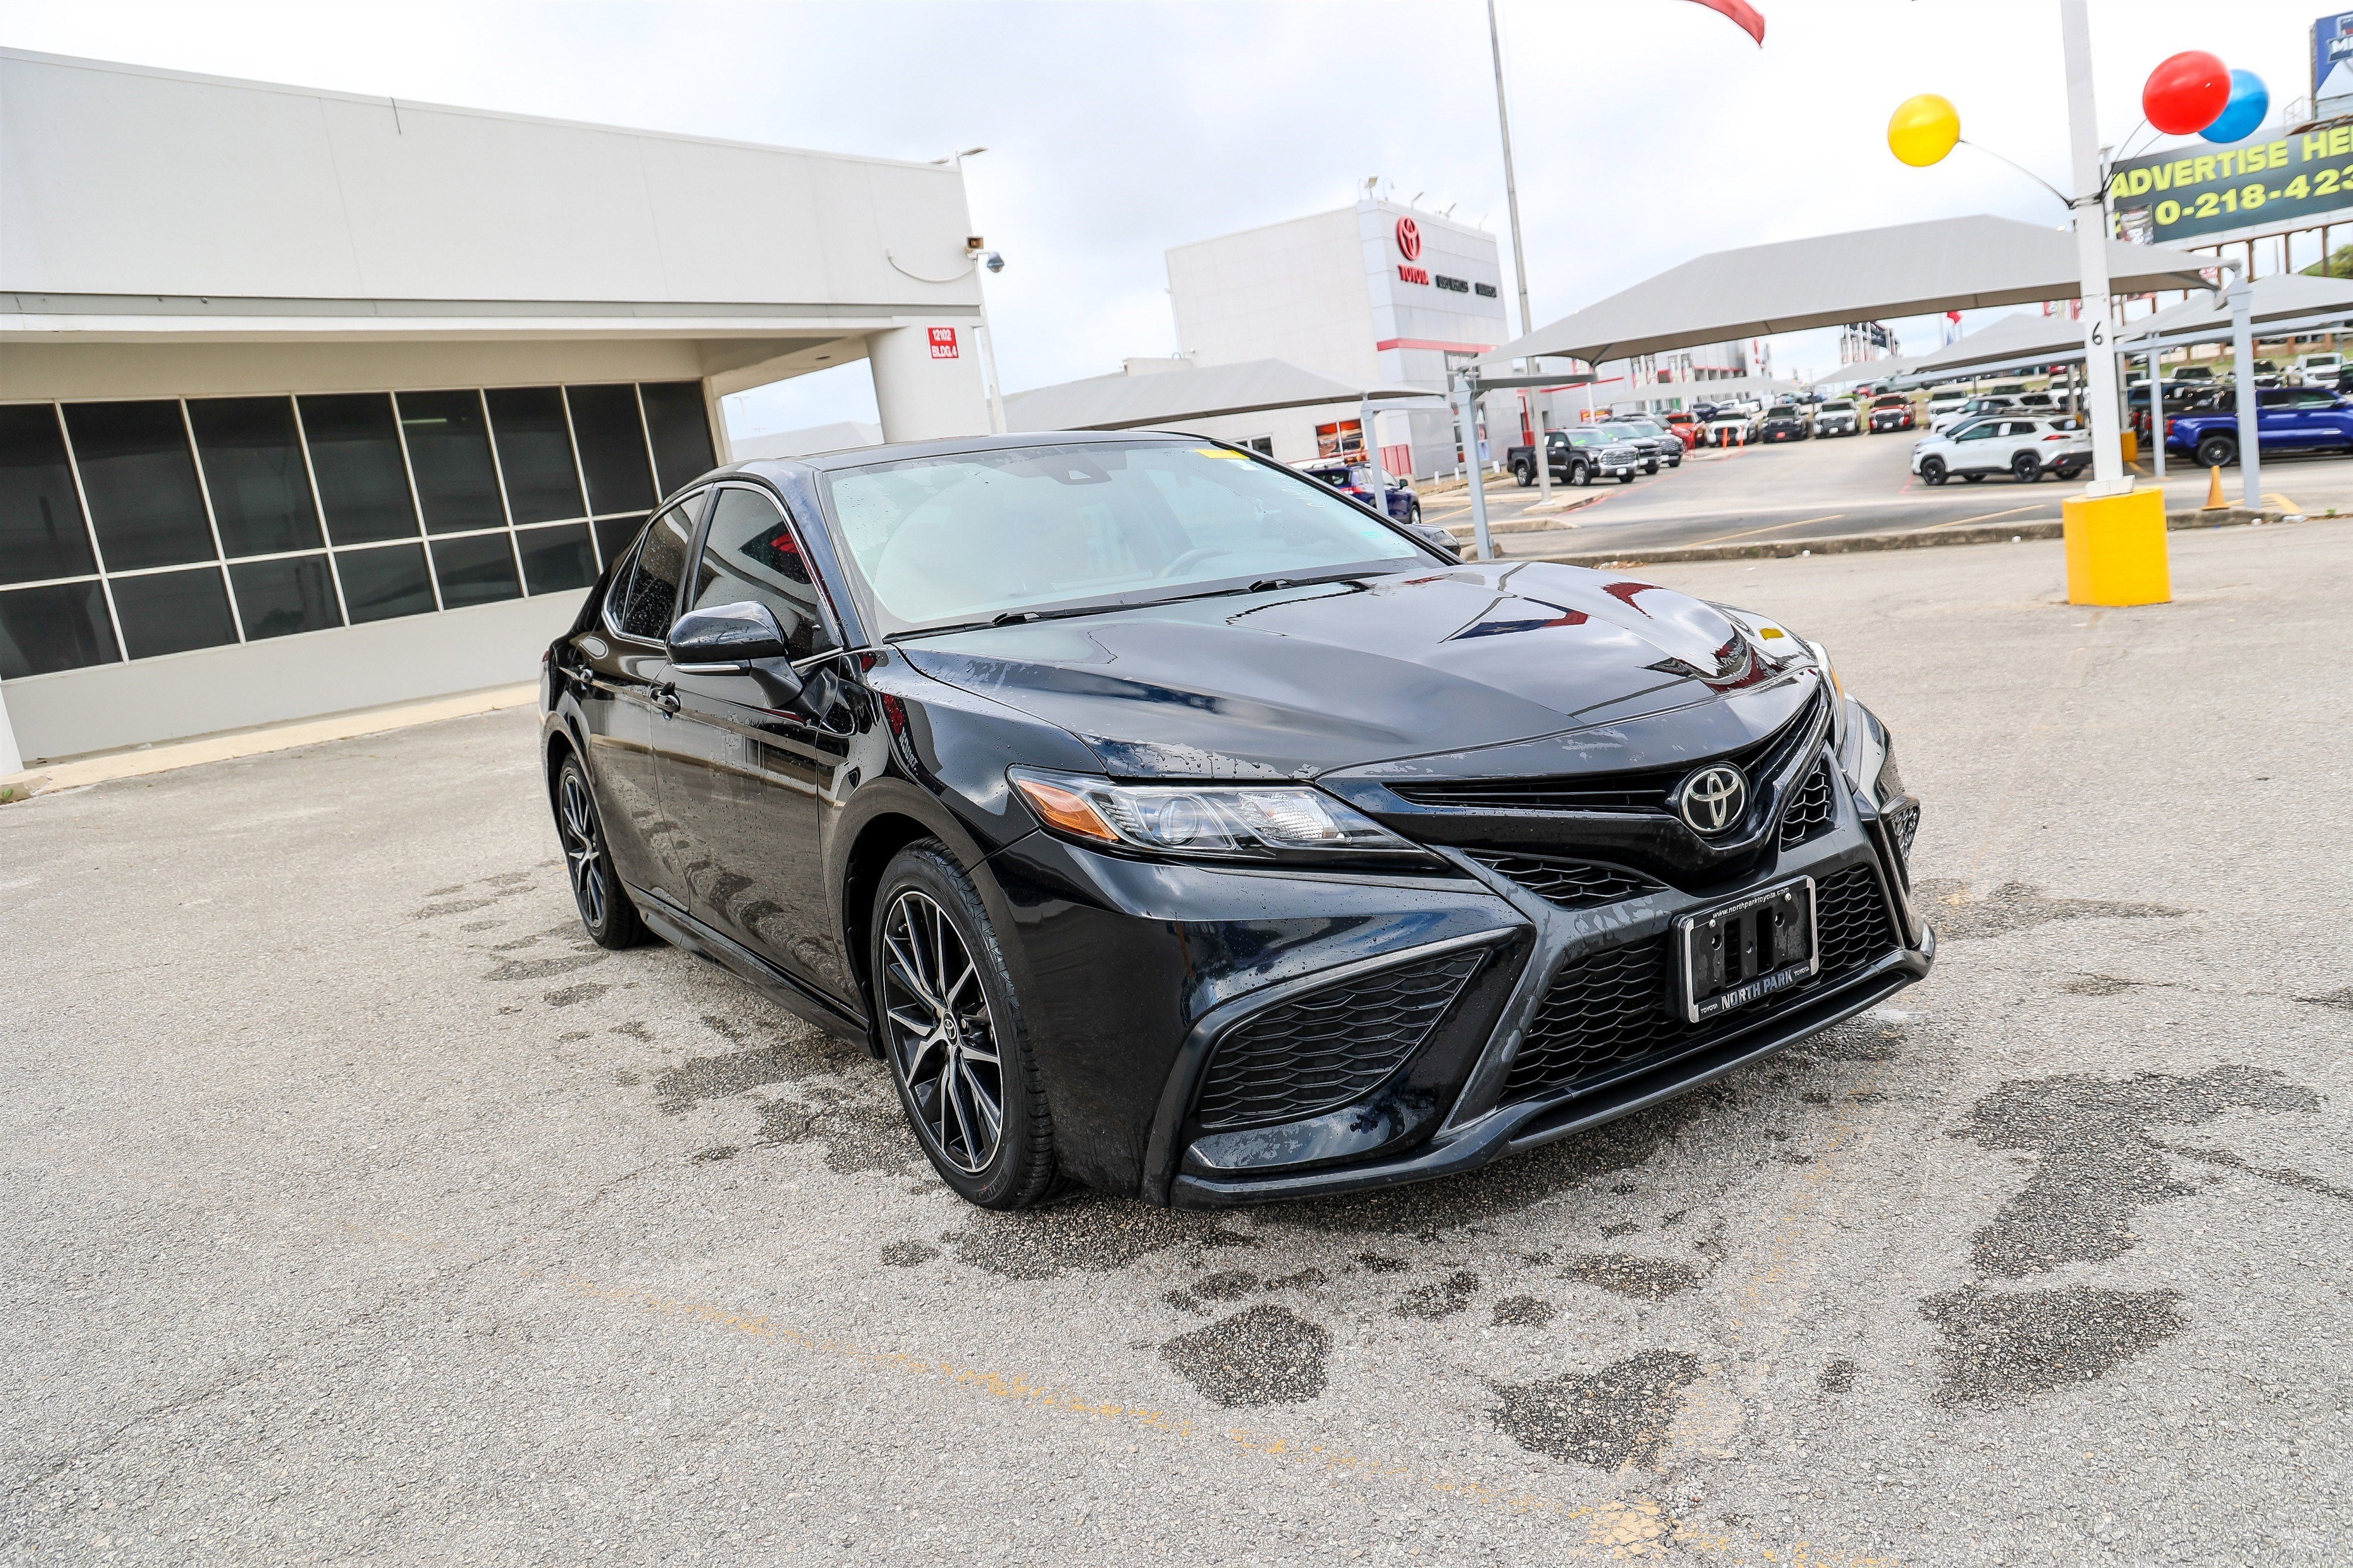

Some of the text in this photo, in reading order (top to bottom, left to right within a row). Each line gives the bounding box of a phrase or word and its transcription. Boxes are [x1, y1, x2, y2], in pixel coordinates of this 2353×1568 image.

[2112, 125, 2353, 199] ADVERTISE HE
[932, 329, 952, 341] 12102
[2092, 320, 2102, 345] 6
[1712, 887, 1789, 918] www.northparktoyota.com
[1700, 966, 1810, 1014] TOYOTA NORTH PARK TOYOTA
